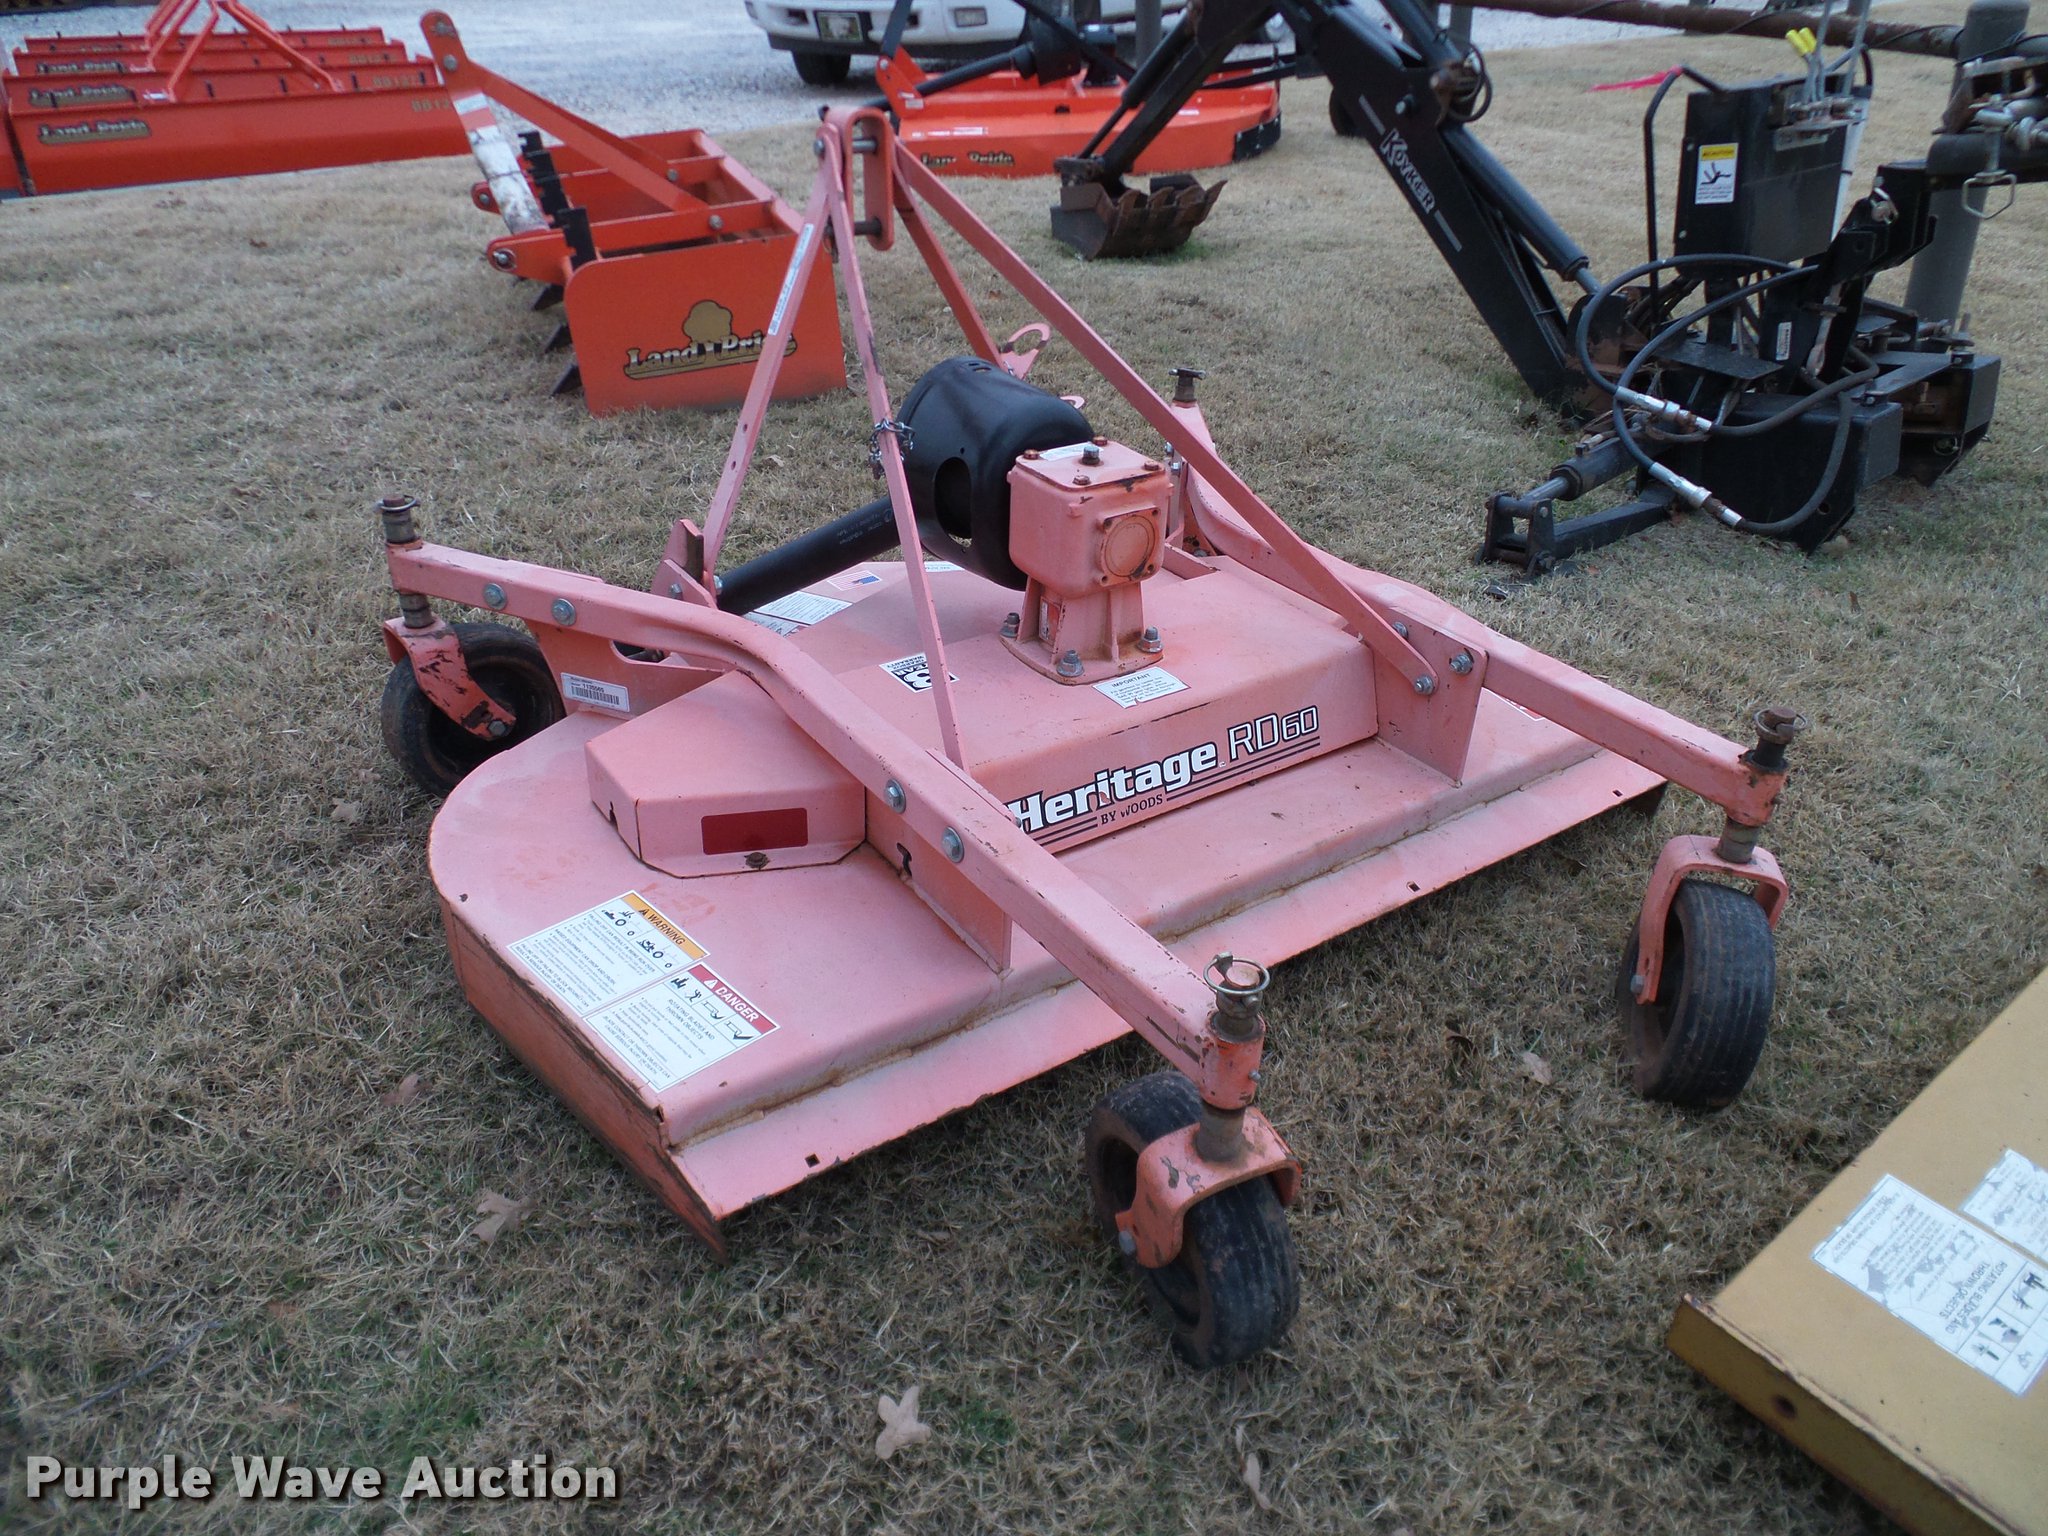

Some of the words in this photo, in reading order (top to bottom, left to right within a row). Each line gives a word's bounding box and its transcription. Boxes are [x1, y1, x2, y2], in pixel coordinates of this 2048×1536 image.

[40, 123, 91, 136] Land
[95, 119, 147, 133] Pride
[626, 341, 699, 368] Land
[1112, 673, 1150, 688] IMPORTANT
[1007, 741, 1219, 832] Heritage
[1227, 705, 1319, 762] RD60
[1101, 810, 1117, 825] BY
[1120, 794, 1164, 819] WOODS
[647, 911, 686, 946] WARNING
[715, 986, 760, 1023] DANGER
